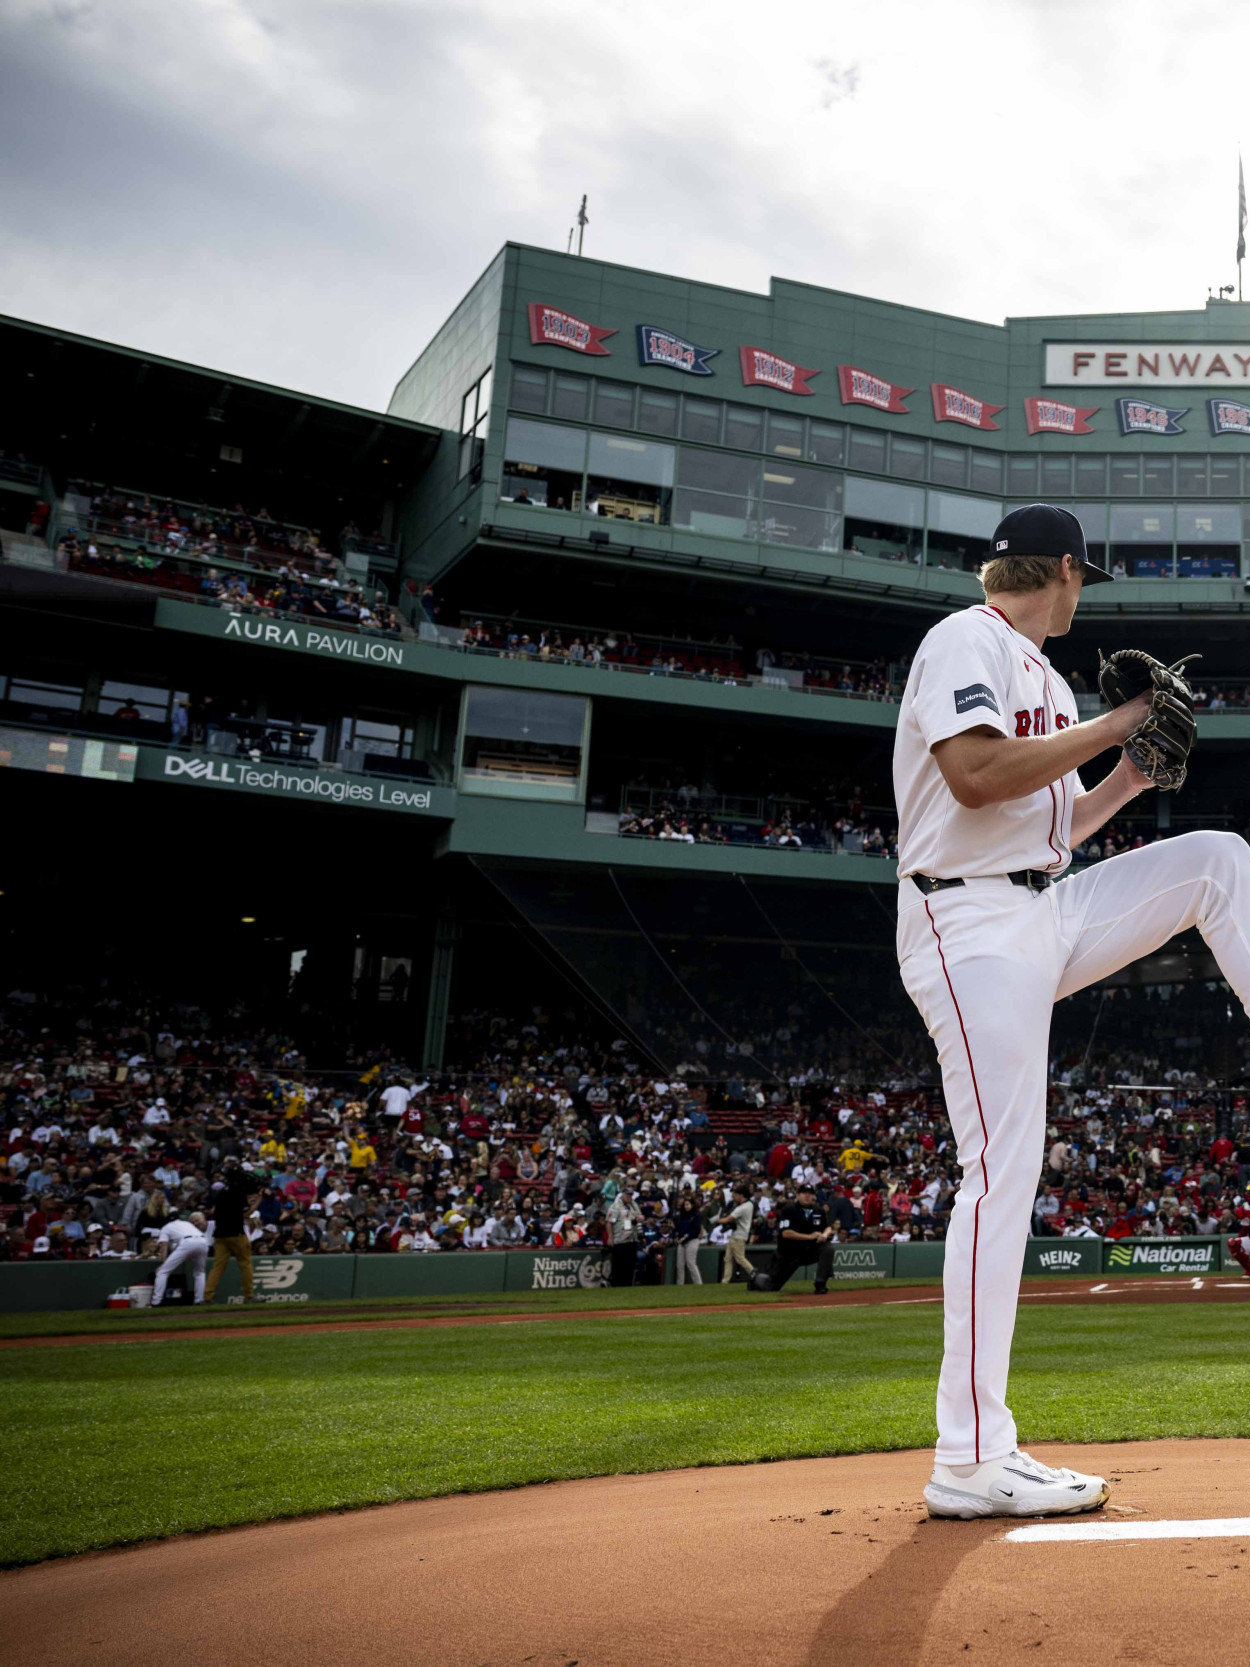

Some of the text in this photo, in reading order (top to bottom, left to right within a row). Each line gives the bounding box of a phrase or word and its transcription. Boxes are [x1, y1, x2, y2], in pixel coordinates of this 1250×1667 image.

[541, 315, 591, 345] 1903
[649, 337, 695, 366] 1904
[754, 358, 795, 383] 1912
[852, 377, 891, 401] 1915
[945, 395, 982, 418] 1916
[1038, 406, 1075, 425] 1918
[1127, 408, 1168, 427] 1946
[306, 631, 404, 665] PAVILION
[1014, 706, 1046, 738] RE
[164, 755, 431, 809] DELL Technologies Level
[533, 1257, 580, 1273] Ninety
[1039, 1249, 1082, 1267] HEINZ
[1132, 1244, 1213, 1264] National
[1160, 1263, 1210, 1272] Car Rental
[532, 1271, 577, 1289] Nine
